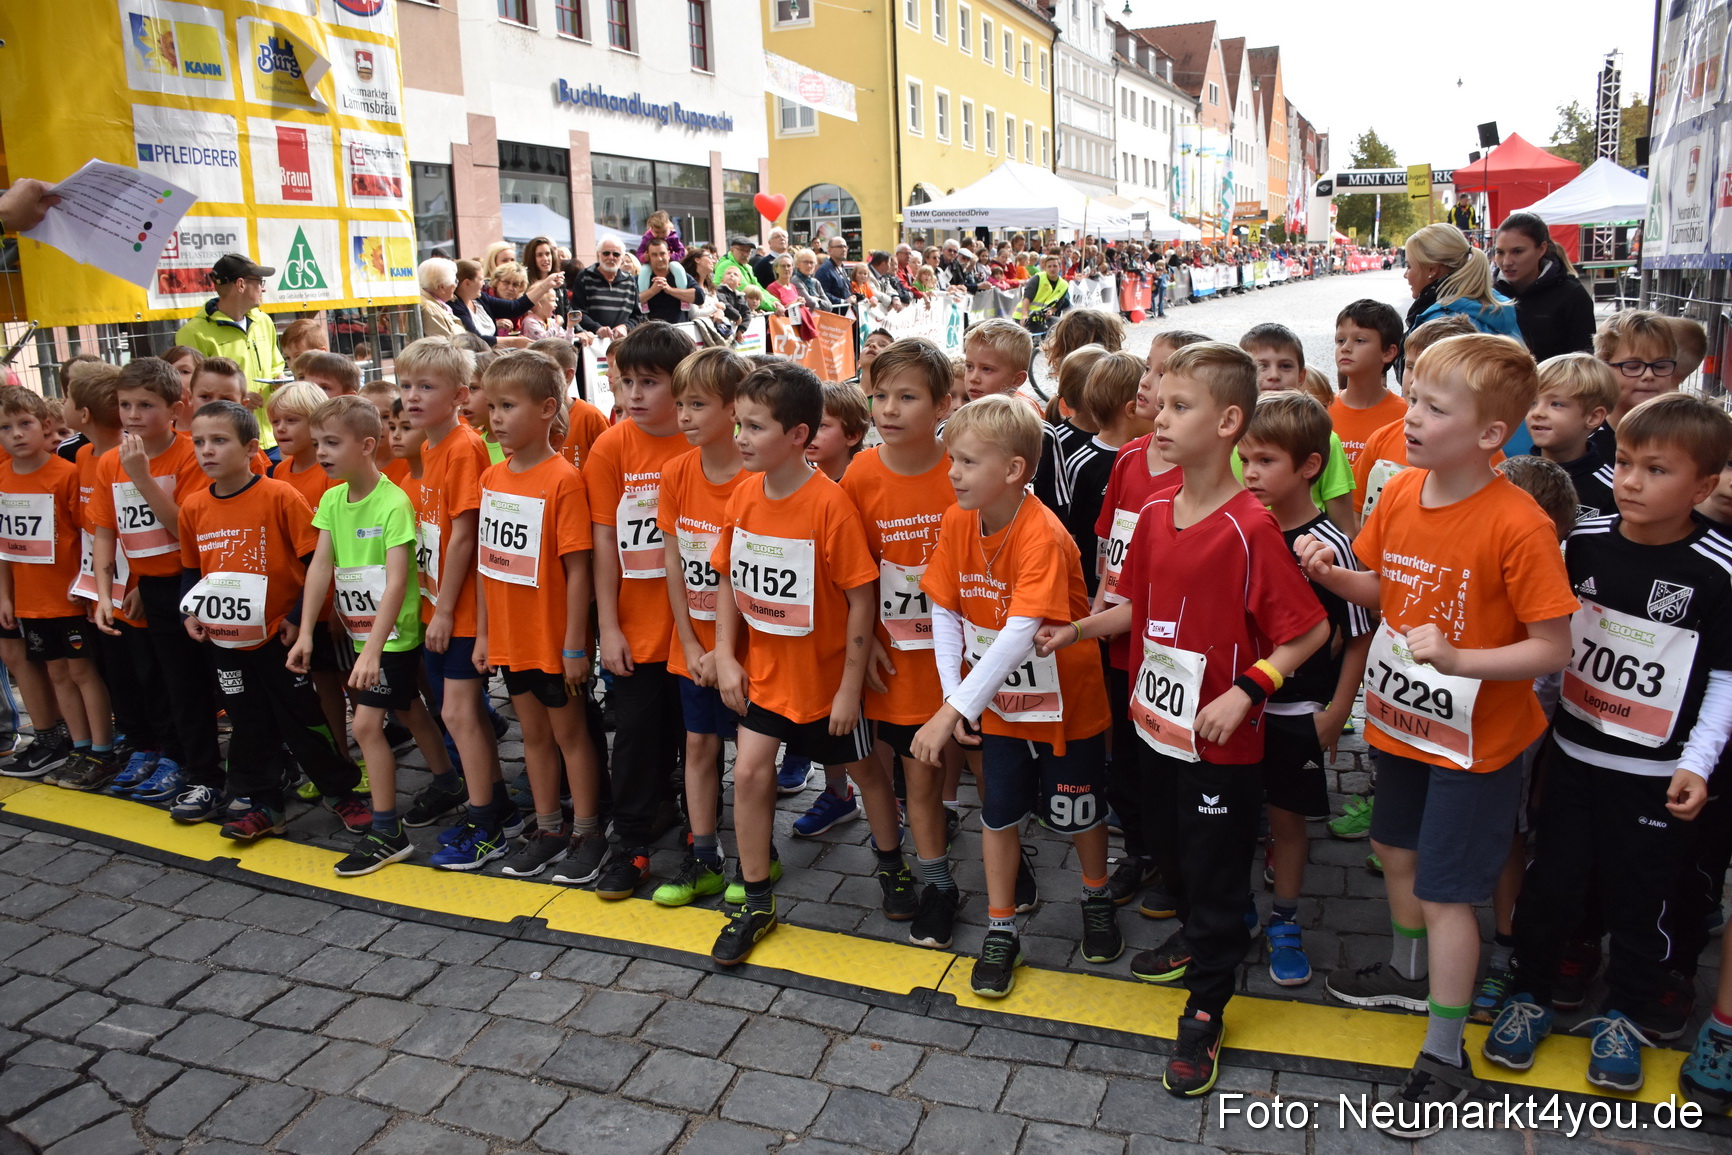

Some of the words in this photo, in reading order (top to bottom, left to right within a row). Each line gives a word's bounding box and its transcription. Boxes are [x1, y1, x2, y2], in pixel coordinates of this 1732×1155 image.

[184, 60, 222, 77] KANN
[257, 42, 302, 80] Burg
[347, 85, 389, 100] Neumarkter
[342, 95, 397, 116] Lammsbräu
[557, 78, 669, 126] Buchhandlung
[673, 101, 734, 132] Rupprecht
[154, 143, 239, 168] PFLEIDERER
[280, 166, 310, 187] Braun
[1348, 173, 1379, 185] MINI
[1408, 174, 1429, 182] Jugend
[931, 209, 989, 217] ConnectedDrive
[180, 231, 237, 249] Egner
[1250, 229, 1258, 239] A
[390, 266, 413, 277] KANN
[496, 500, 520, 512] BOCK
[122, 503, 156, 529] 725
[484, 516, 528, 550] 7165
[8, 542, 27, 551] Lukas
[752, 544, 784, 556] BOCK
[489, 553, 510, 567] Marlon
[212, 579, 241, 587] BOCK
[738, 559, 797, 598] 7152
[192, 595, 251, 622] 7035
[749, 601, 786, 618] Johannes
[1453, 568, 1471, 641] BAMBINI
[1658, 598, 1688, 620] TSV
[206, 626, 240, 637] Raphael
[350, 620, 373, 628] Marlon
[1609, 622, 1656, 644] BOCK
[1576, 637, 1665, 699] 7063
[1378, 659, 1453, 720] 7229
[1583, 689, 1631, 718] Leopold
[1145, 714, 1161, 733] Felix
[1379, 701, 1431, 739] FINN
[1057, 783, 1091, 794] RACING
[1050, 793, 1096, 827] 90
[1198, 805, 1228, 815] erima
[1647, 819, 1667, 828] JAKO
